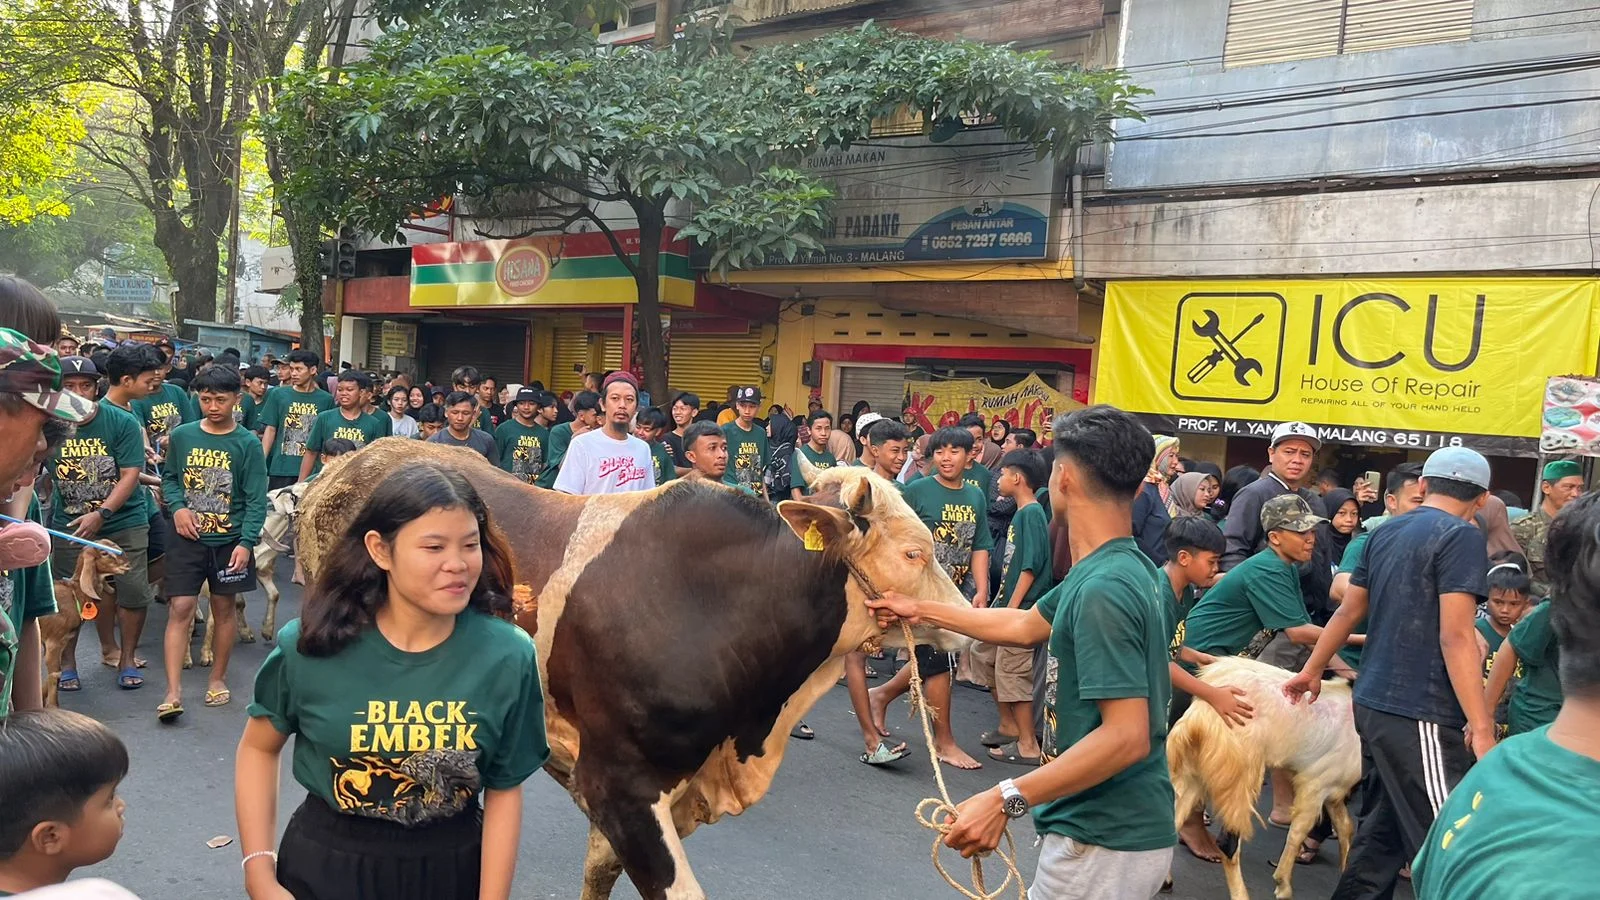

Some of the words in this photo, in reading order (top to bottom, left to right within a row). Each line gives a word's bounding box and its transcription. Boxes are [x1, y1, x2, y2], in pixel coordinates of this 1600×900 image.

[807, 155, 842, 168] RUMAH
[846, 151, 886, 165] MAKAN
[844, 213, 900, 239] PADANG
[951, 219, 980, 230] PESAN
[981, 217, 1014, 229] ANTAR
[829, 252, 844, 263] No.
[848, 253, 853, 262] 3
[860, 250, 905, 262] MALANG
[1308, 292, 1486, 372] ICU
[1300, 374, 1364, 392] House
[1371, 376, 1399, 394] Of
[1405, 378, 1482, 400] Repair
[981, 393, 1018, 409] RUMAH
[1301, 397, 1348, 407] REPAIRING
[1352, 400, 1369, 408] ALL
[1391, 402, 1417, 410] YOUR
[1422, 404, 1449, 412] HAND
[1452, 405, 1481, 414] HELD
[1178, 418, 1218, 432] PROF.
[1224, 421, 1241, 434] M.
[1246, 421, 1278, 436] YAM
[1318, 427, 1387, 444] MALANG
[1393, 433, 1463, 448] 65118
